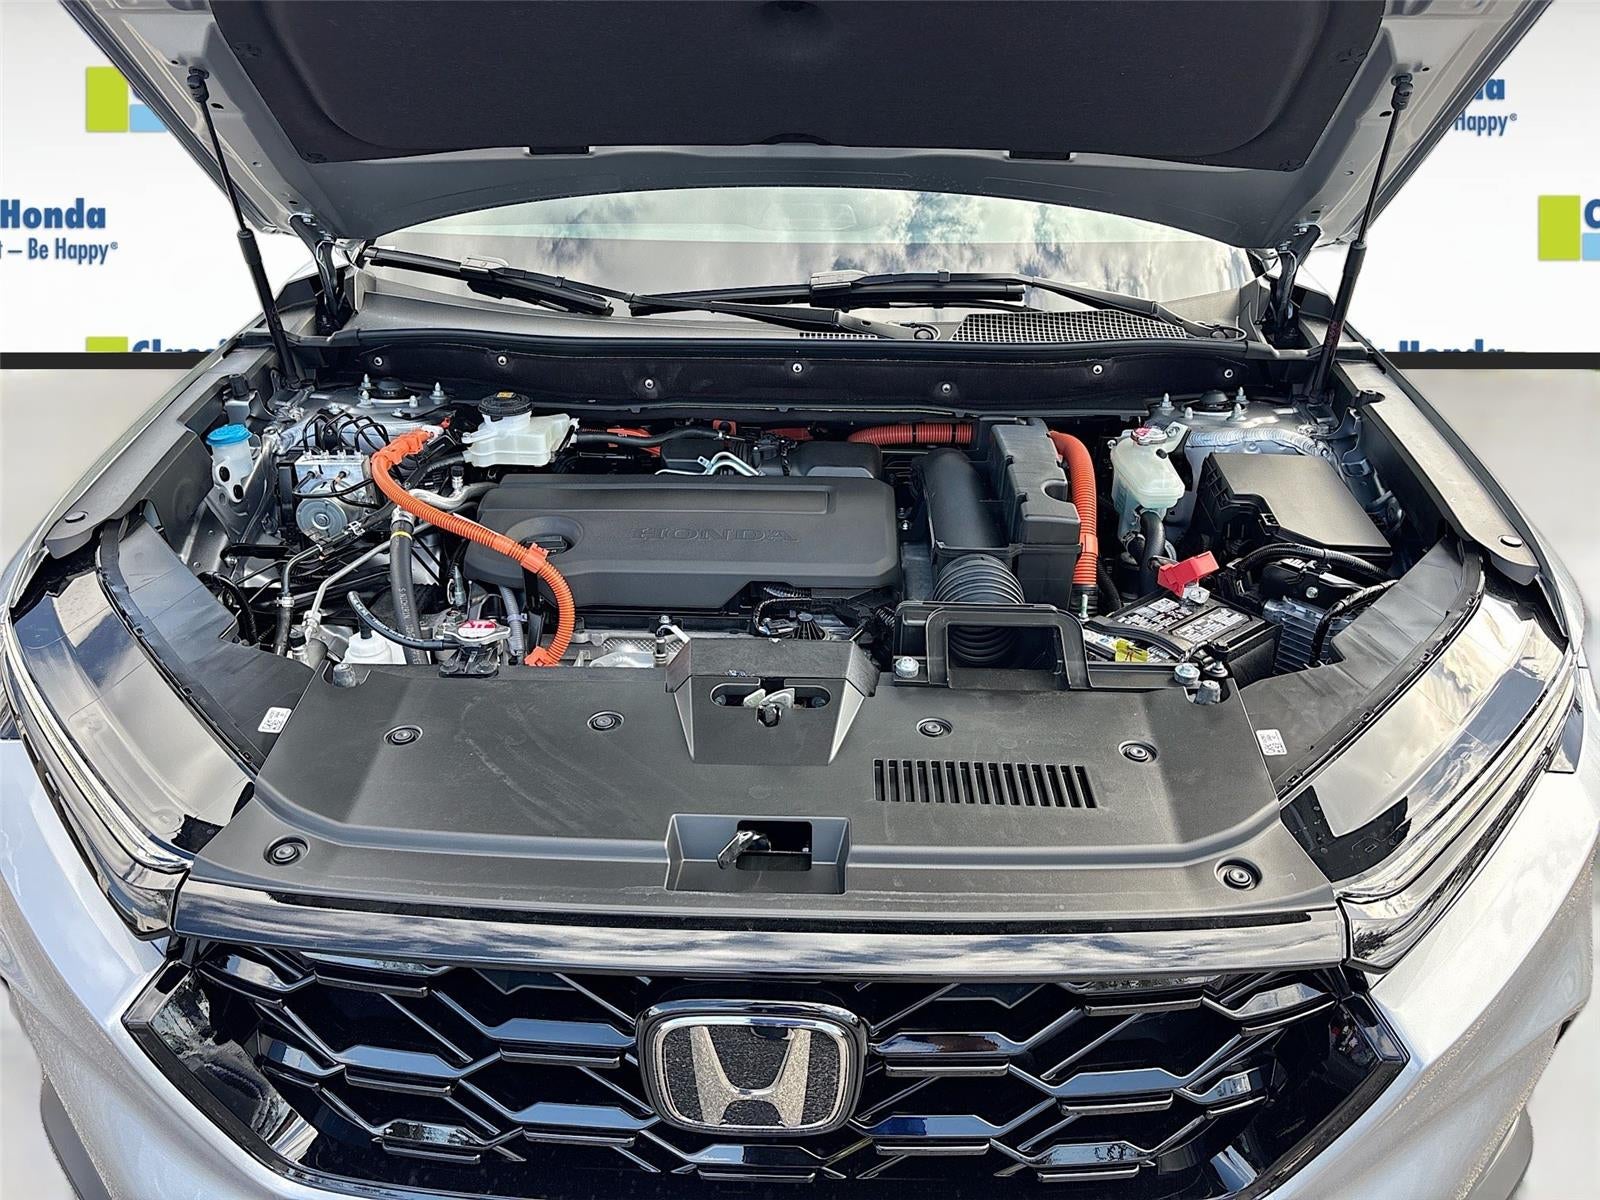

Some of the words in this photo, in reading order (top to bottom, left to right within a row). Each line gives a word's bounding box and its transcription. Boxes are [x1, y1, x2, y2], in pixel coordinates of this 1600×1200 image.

[0, 197, 106, 229] Honda
[28, 237, 49, 260] Be
[632, 527, 800, 543] HONDA
